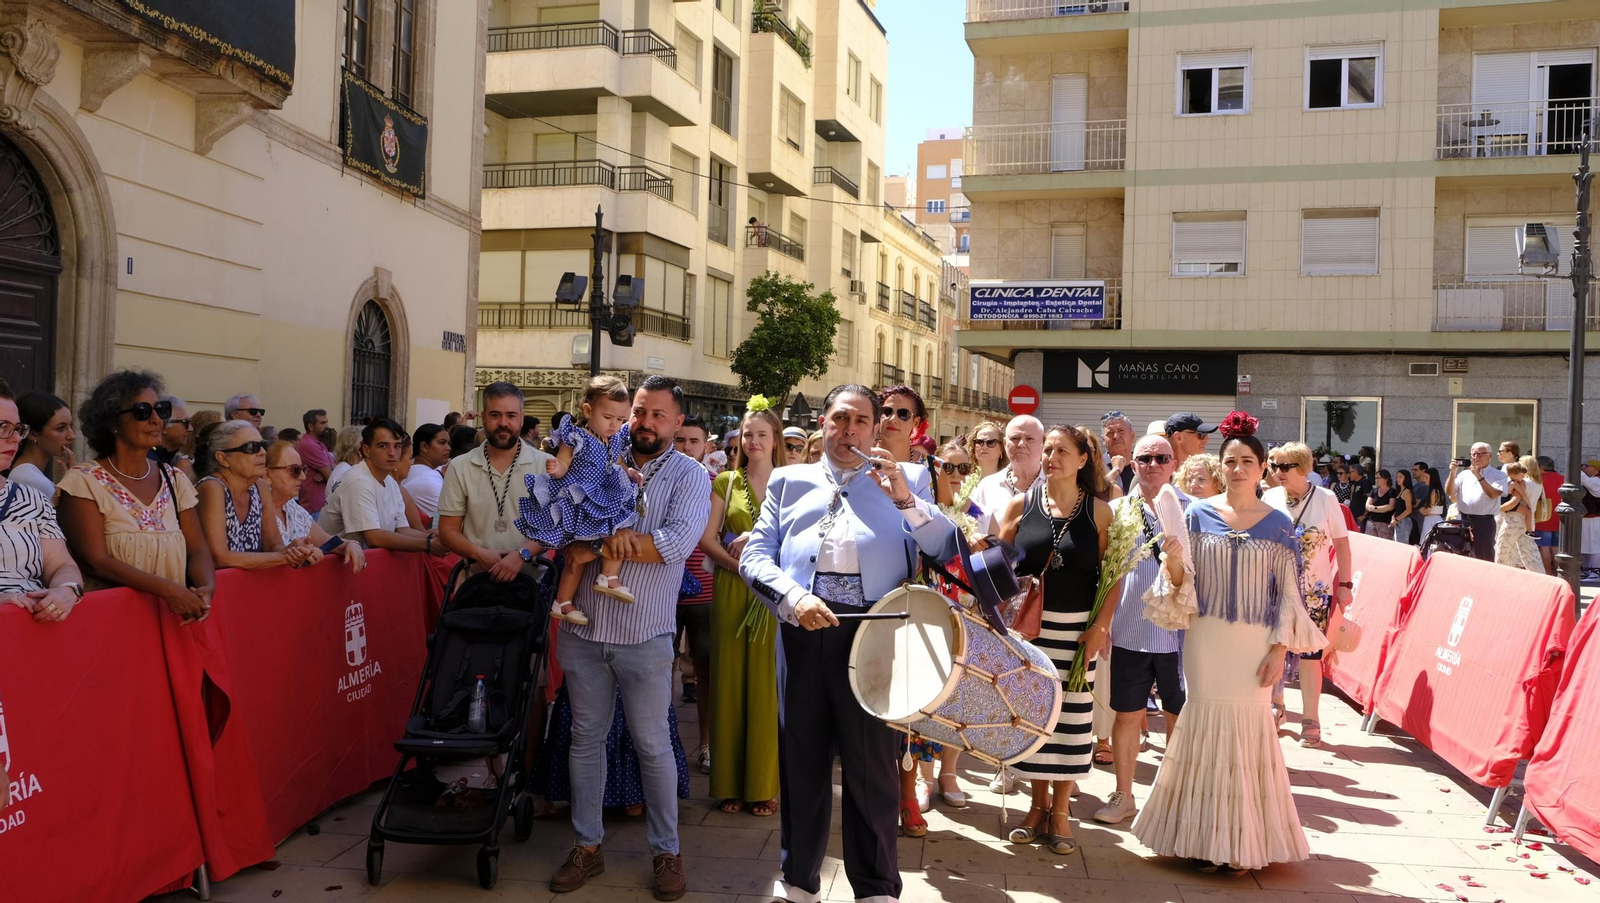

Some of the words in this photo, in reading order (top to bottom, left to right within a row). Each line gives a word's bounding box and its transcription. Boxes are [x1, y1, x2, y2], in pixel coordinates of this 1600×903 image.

[974, 288, 1034, 298] CLINICA
[1039, 287, 1100, 298] DENTAL
[995, 307, 1033, 315] Alejandro
[1118, 361, 1159, 373] MAÑAS
[1164, 363, 1200, 373] CANO
[337, 659, 382, 694] ALMERÍA
[346, 683, 372, 703] CIUDAD
[5, 772, 43, 807] RÍA
